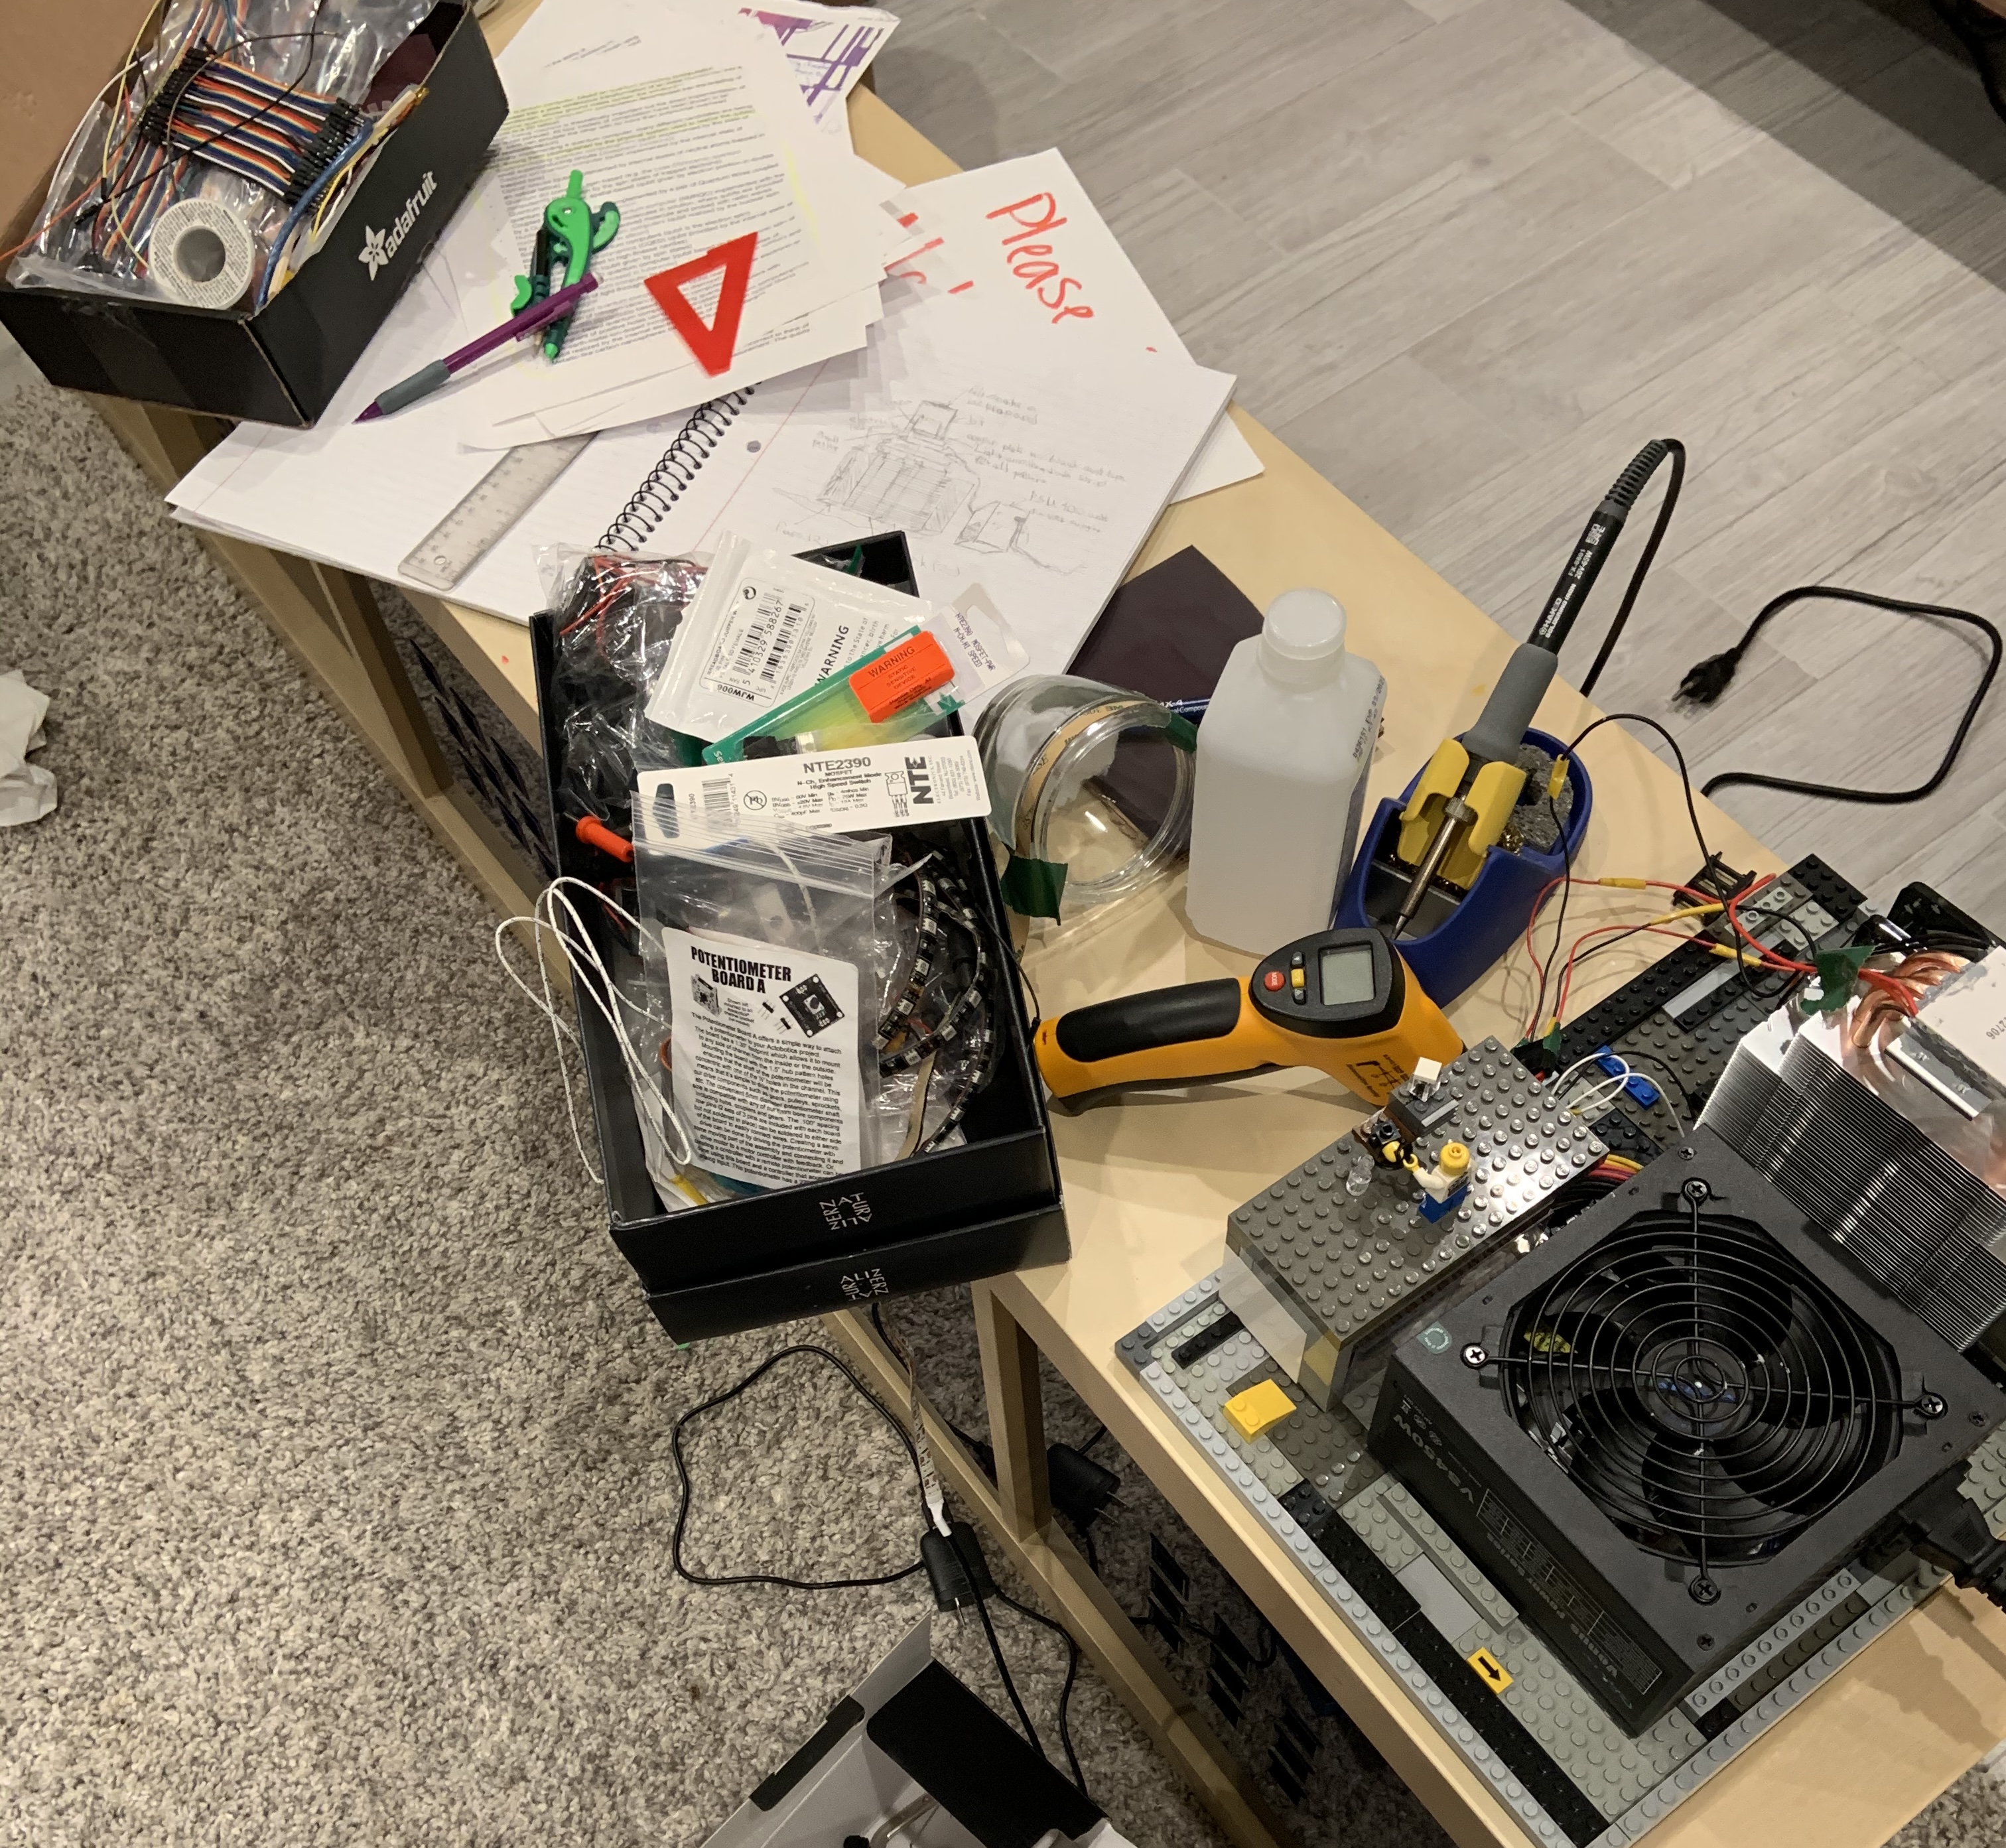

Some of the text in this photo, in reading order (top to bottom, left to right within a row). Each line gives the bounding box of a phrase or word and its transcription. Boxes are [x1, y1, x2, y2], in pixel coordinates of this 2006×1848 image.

[384, 170, 438, 259] adafruit
[986, 192, 1095, 324] Please
[747, 638, 768, 674] 410329
[762, 599, 785, 636] 588267
[878, 622, 890, 639] harm
[954, 612, 974, 637] NTE2390
[848, 643, 858, 656] the
[853, 625, 865, 643] State
[858, 620, 879, 660] ancer, birth
[867, 644, 915, 679] WARNING
[967, 649, 983, 669] SPEED
[716, 681, 756, 704] WJW006
[802, 755, 872, 775] NTE2390
[818, 773, 862, 783] Enhancement
[904, 754, 934, 805] NTE
[691, 946, 792, 982] POTENTIOMETER
[711, 968, 766, 994] BOARD A
[1270, 971, 1279, 986] MODE
[1986, 1016, 2006, 1040] 2706
